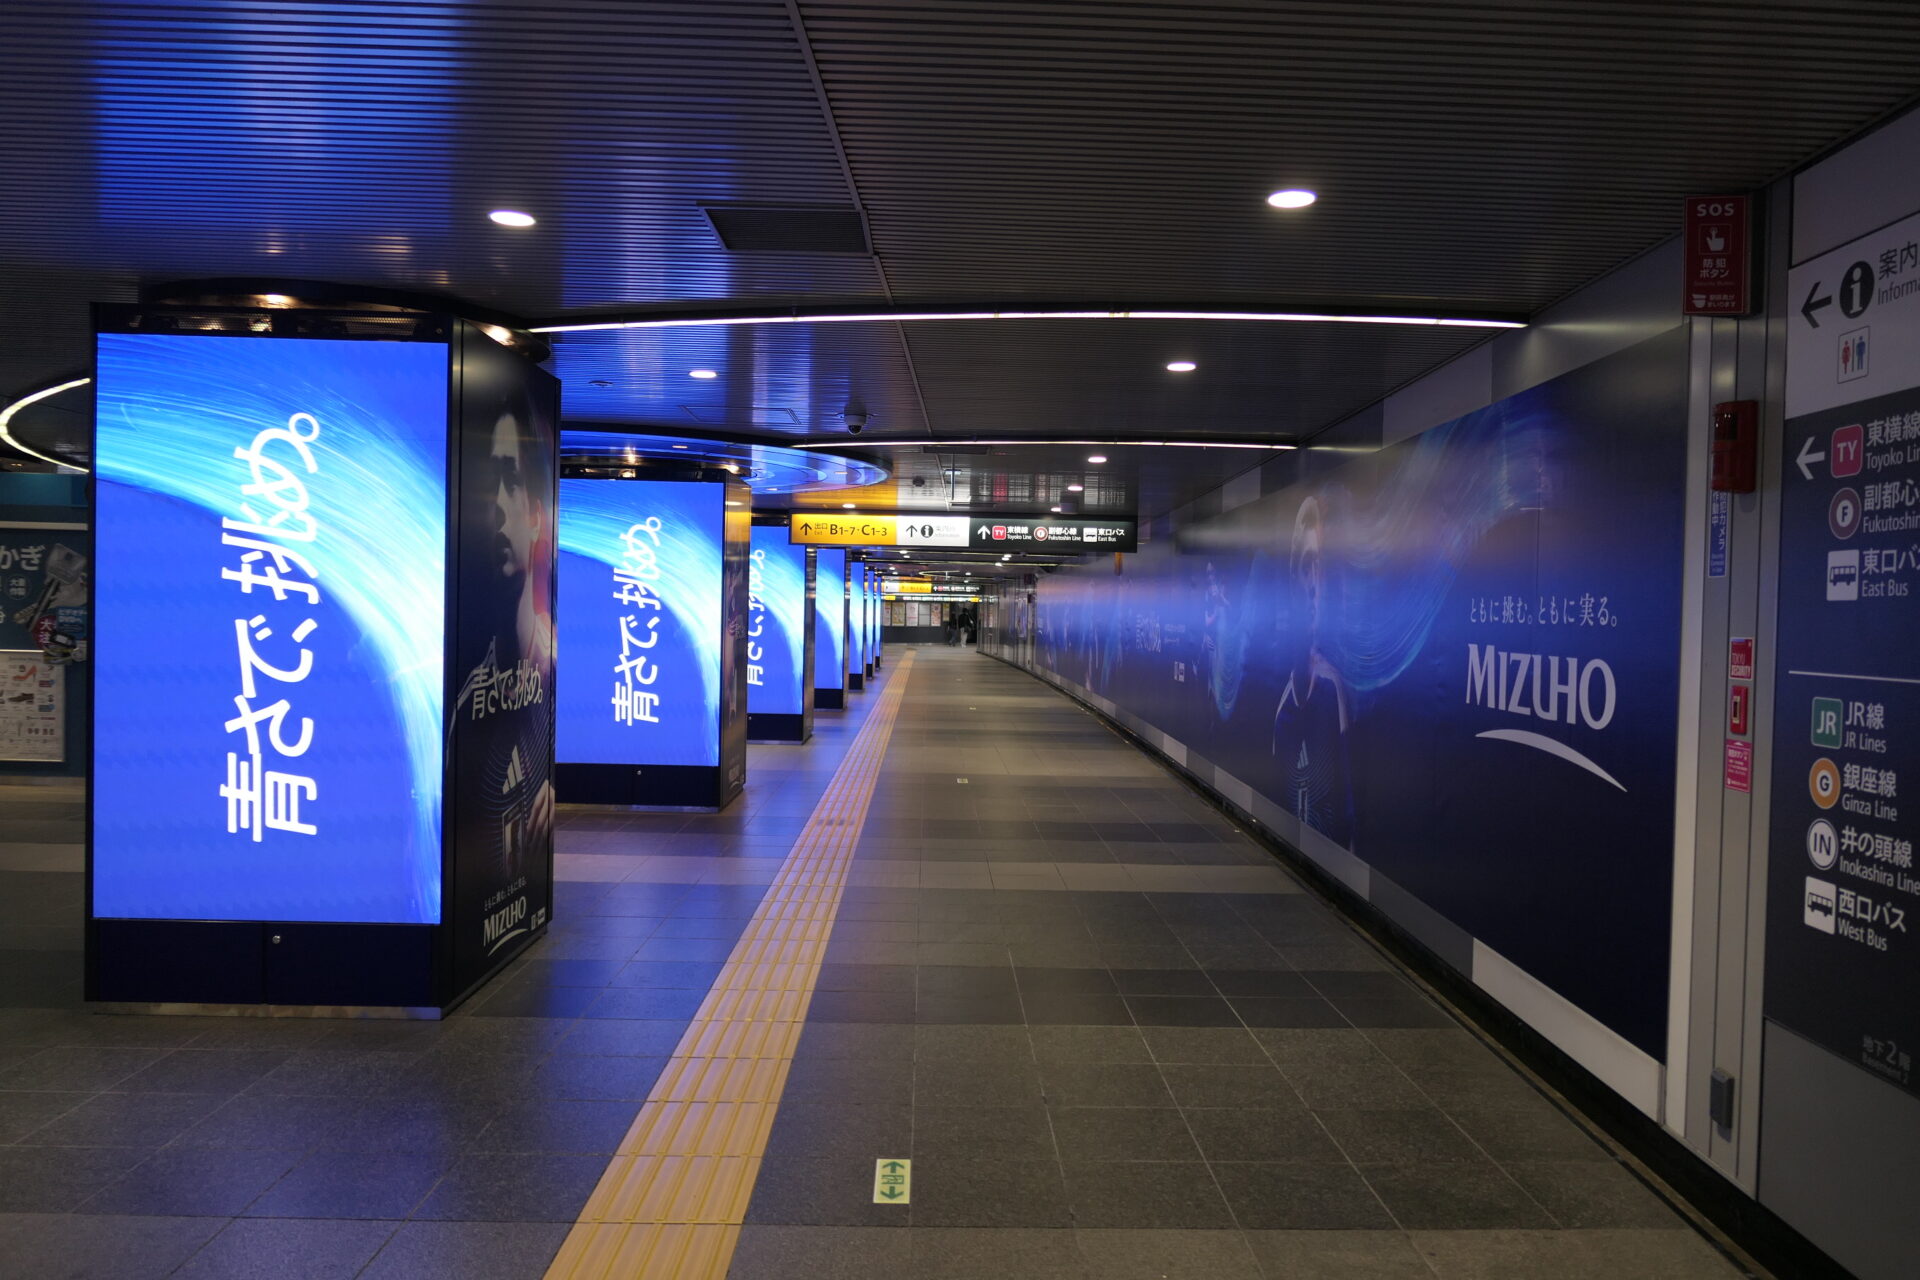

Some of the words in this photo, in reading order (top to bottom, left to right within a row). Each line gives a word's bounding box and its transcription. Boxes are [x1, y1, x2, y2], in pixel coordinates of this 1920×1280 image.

[1696, 203, 1735, 217] SOS
[1878, 280, 1920, 305] Inform
[1837, 440, 1858, 463] TY
[1866, 447, 1904, 472] Toyoko
[1864, 479, 1920, 511] 副都心
[1862, 544, 1920, 575] 東口バ
[1861, 580, 1885, 597] East
[1887, 579, 1909, 597] Bus
[611, 517, 662, 726] 青さで、挑め。
[1470, 593, 1617, 627] ともに挑む。ともに実る。
[219, 411, 320, 842] 青さで、挑め。
[1466, 643, 1616, 730] MIZUHO
[1816, 710, 1837, 736] JR
[1845, 701, 1885, 730] JR線
[1844, 731, 1857, 749] JR
[1859, 733, 1887, 753] Lines
[1820, 775, 1830, 792] G
[1843, 762, 1897, 798] 銀座線
[1842, 793, 1872, 816] Ginza
[1874, 799, 1898, 822] Line
[1814, 832, 1831, 856] IN
[1841, 825, 1912, 868] 井の頭線
[1839, 856, 1895, 888] Inokashira
[1897, 872, 1920, 896] Line
[483, 895, 527, 948] MIZUHO
[1838, 887, 1907, 933] 西口バス
[1838, 917, 1865, 944] West
[1867, 928, 1888, 951] Bus
